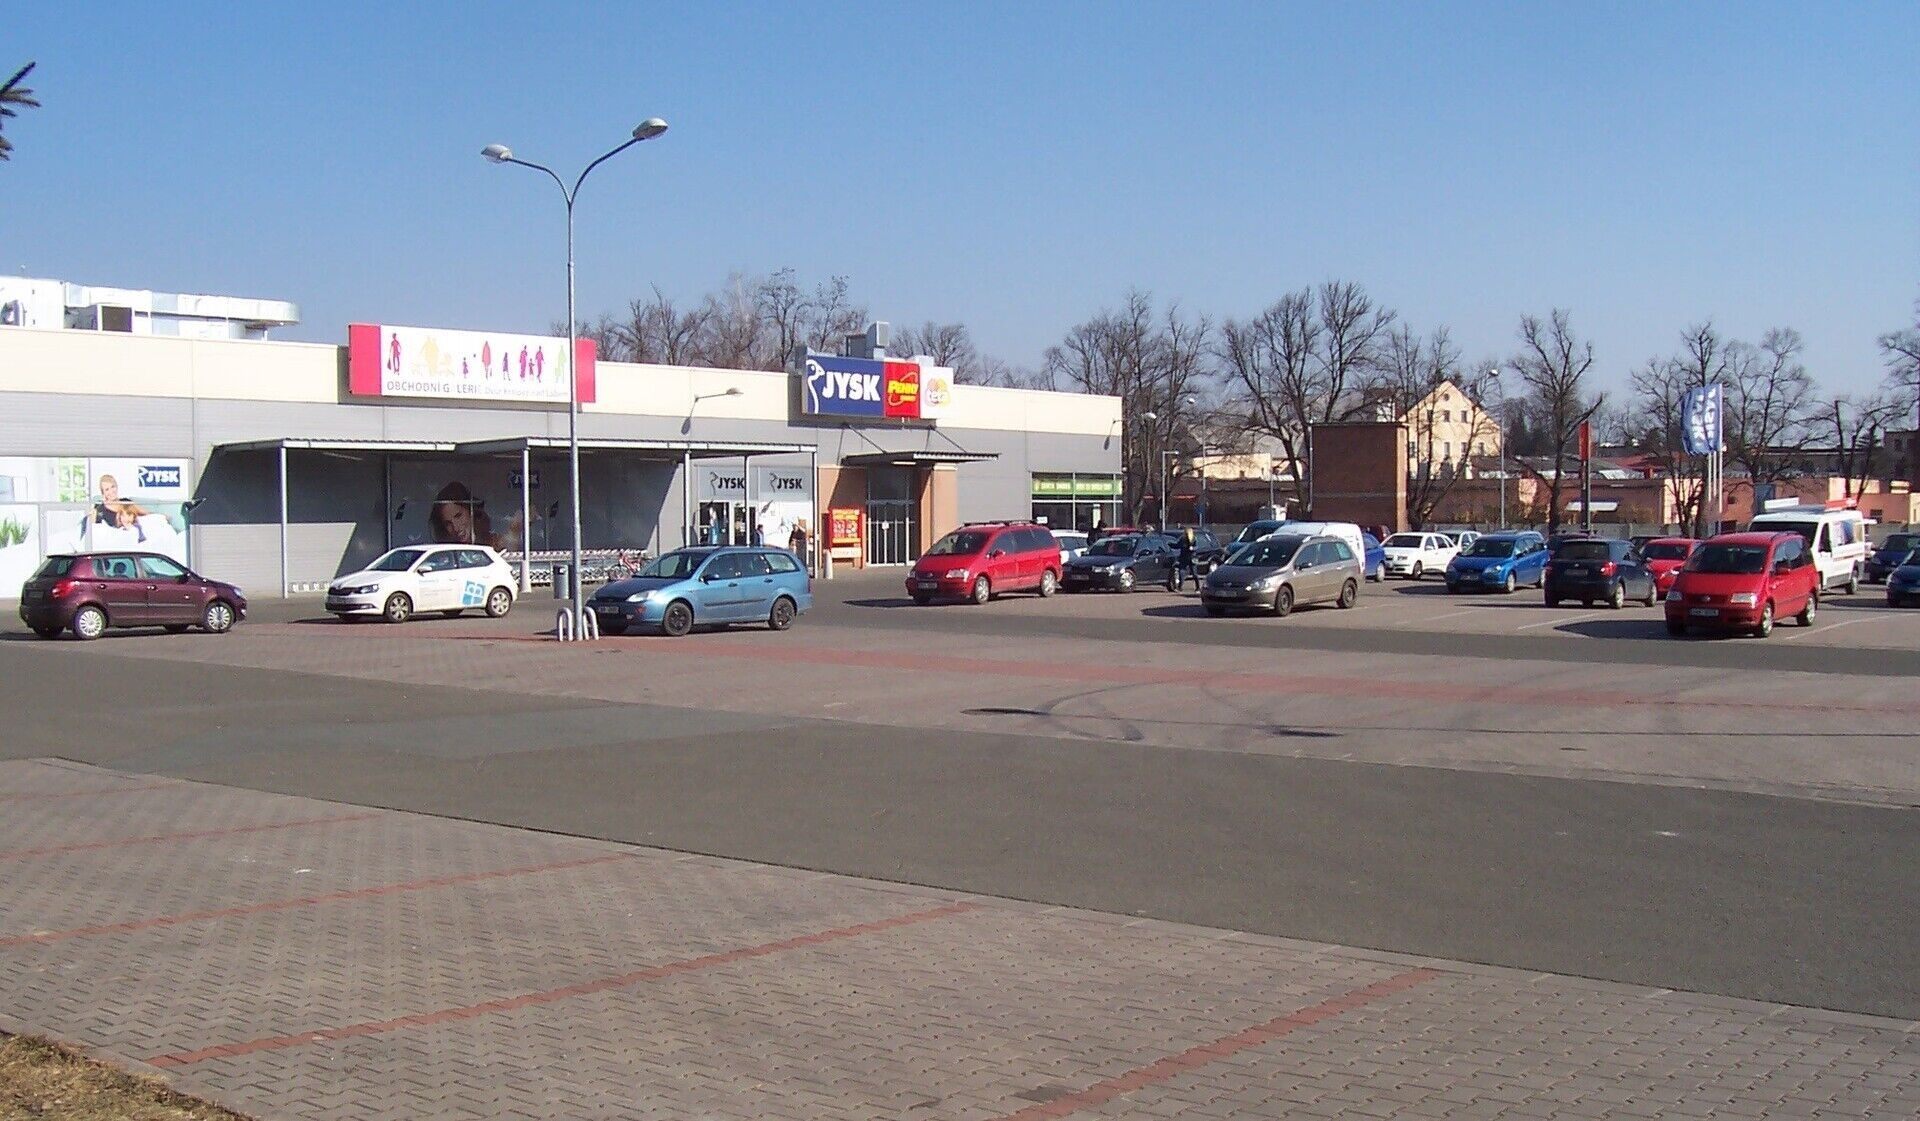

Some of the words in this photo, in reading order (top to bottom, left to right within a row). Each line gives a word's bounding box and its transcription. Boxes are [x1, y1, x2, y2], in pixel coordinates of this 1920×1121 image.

[443, 383, 482, 394] GLERI
[822, 370, 881, 401] JYSK
[145, 470, 179, 483] JYSK
[717, 477, 746, 489] JYSK
[777, 478, 803, 490] JYSK
